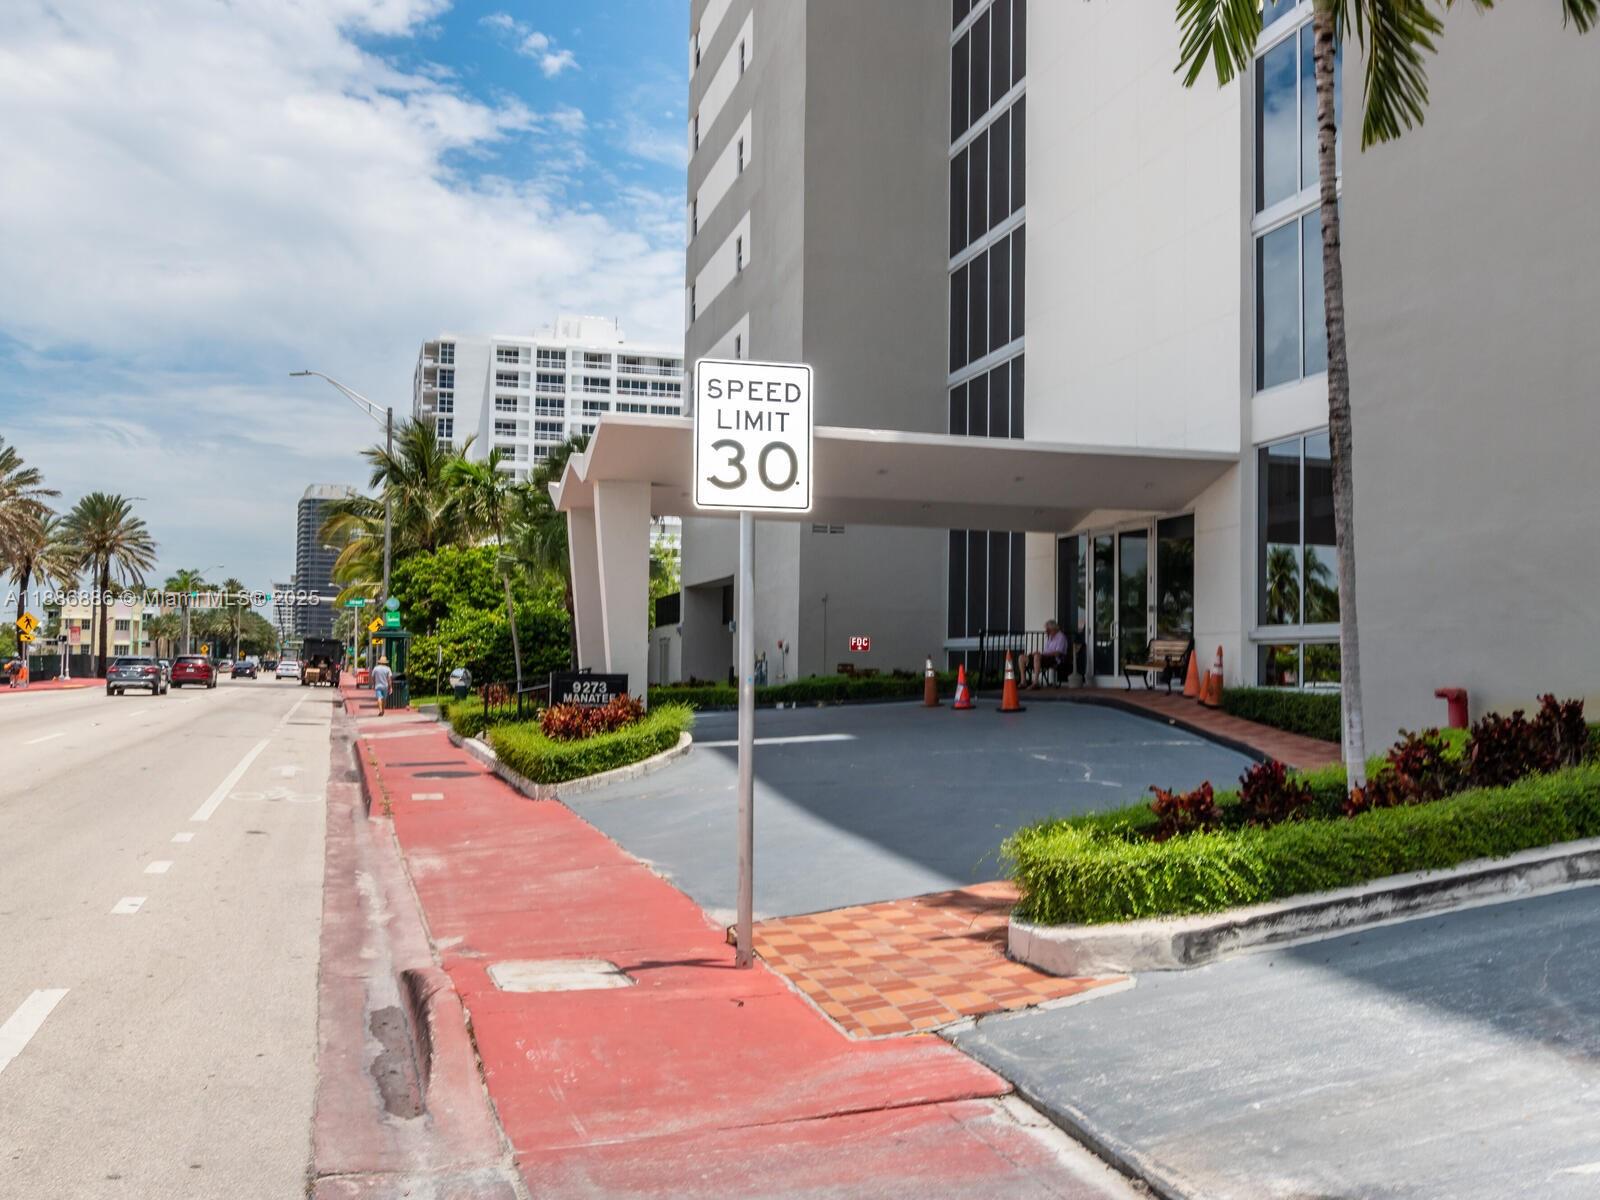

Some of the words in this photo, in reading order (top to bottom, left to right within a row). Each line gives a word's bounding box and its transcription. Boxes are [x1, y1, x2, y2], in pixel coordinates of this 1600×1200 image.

[707, 378, 801, 402] SPEED
[717, 409, 789, 432] LIMIT
[708, 439, 798, 492] 30
[851, 637, 868, 646] FDC
[572, 681, 607, 693] 9273
